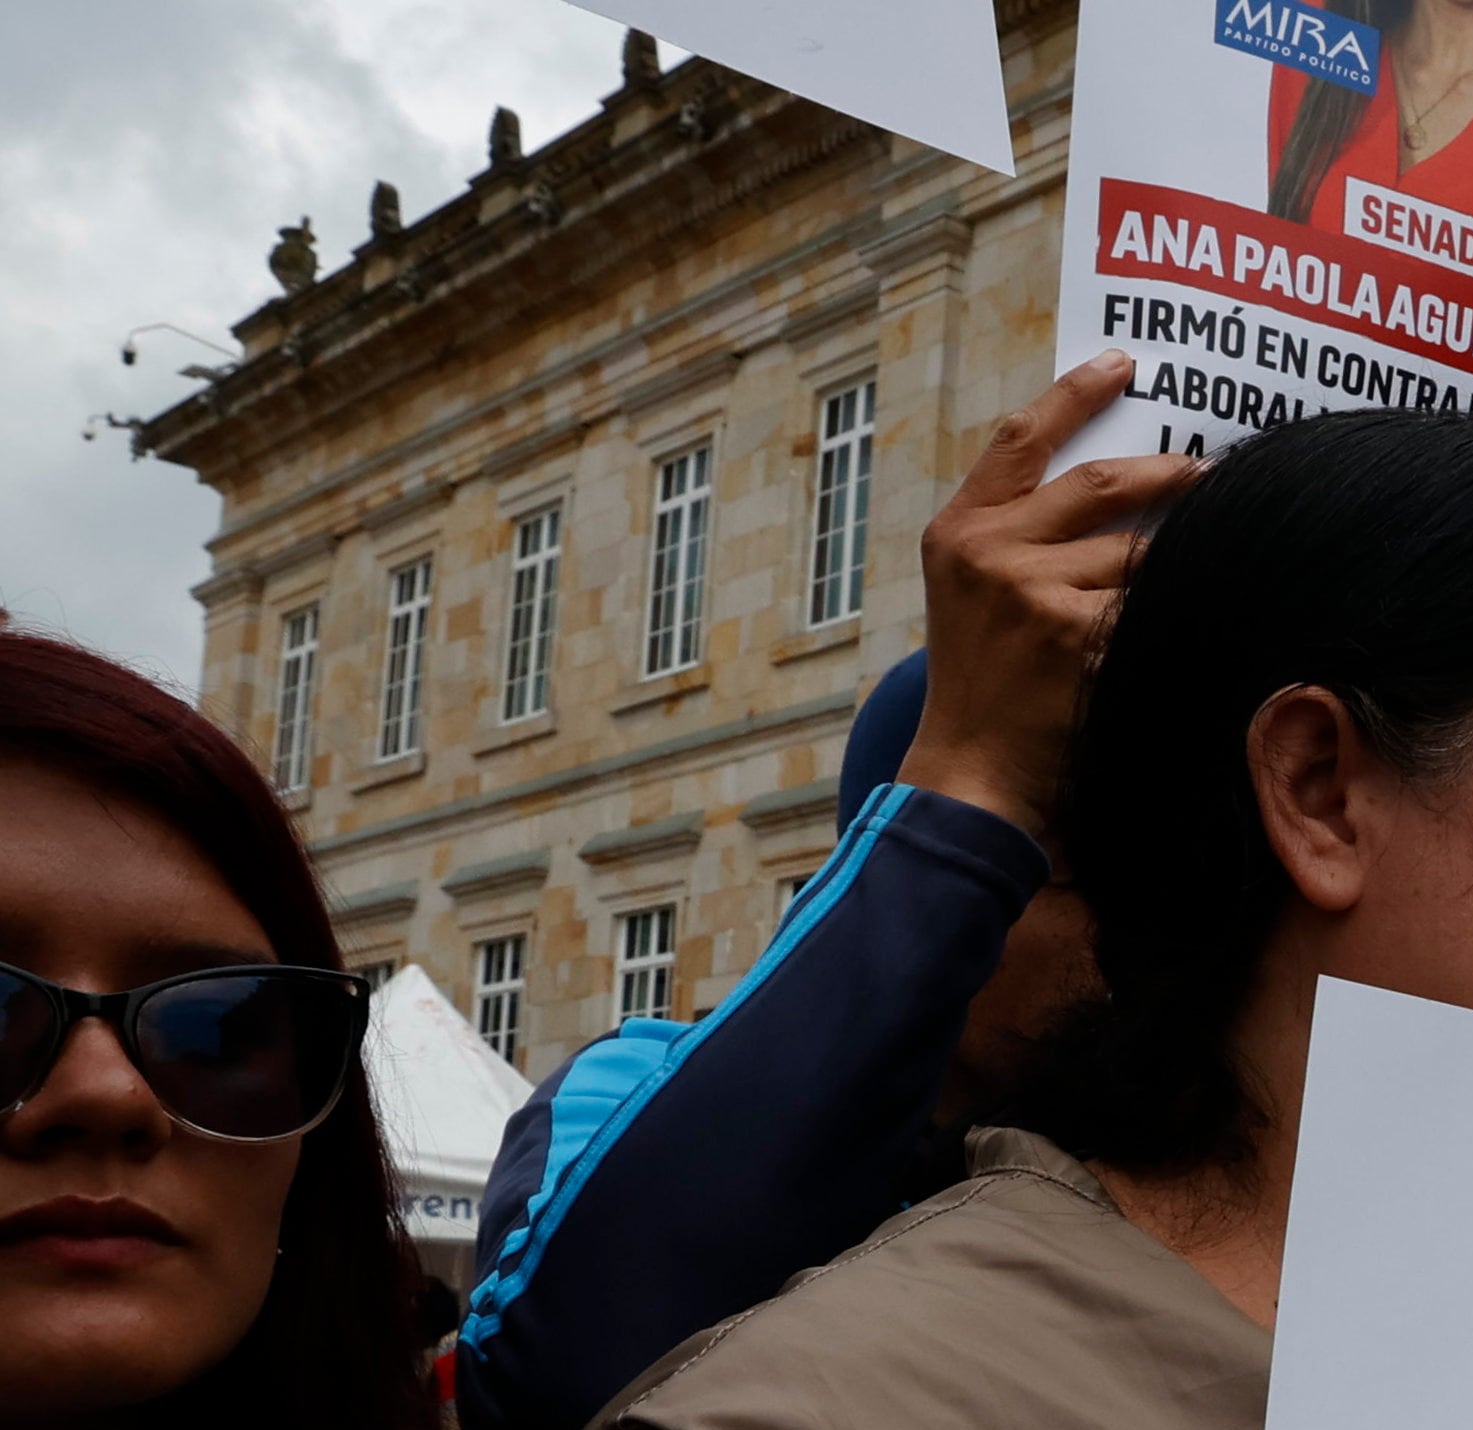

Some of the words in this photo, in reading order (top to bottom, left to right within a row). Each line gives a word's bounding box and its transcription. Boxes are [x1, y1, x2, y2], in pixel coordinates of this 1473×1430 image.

[1224, 27, 1292, 57] PARTIDO
[1299, 52, 1372, 86] POLÍTICO
[1225, 0, 1370, 72] MIRA
[1110, 209, 1225, 278] ANA
[1233, 233, 1382, 327] PAOLA
[1103, 293, 1246, 360] FIRMÓ
[1256, 325, 1309, 380] EN
